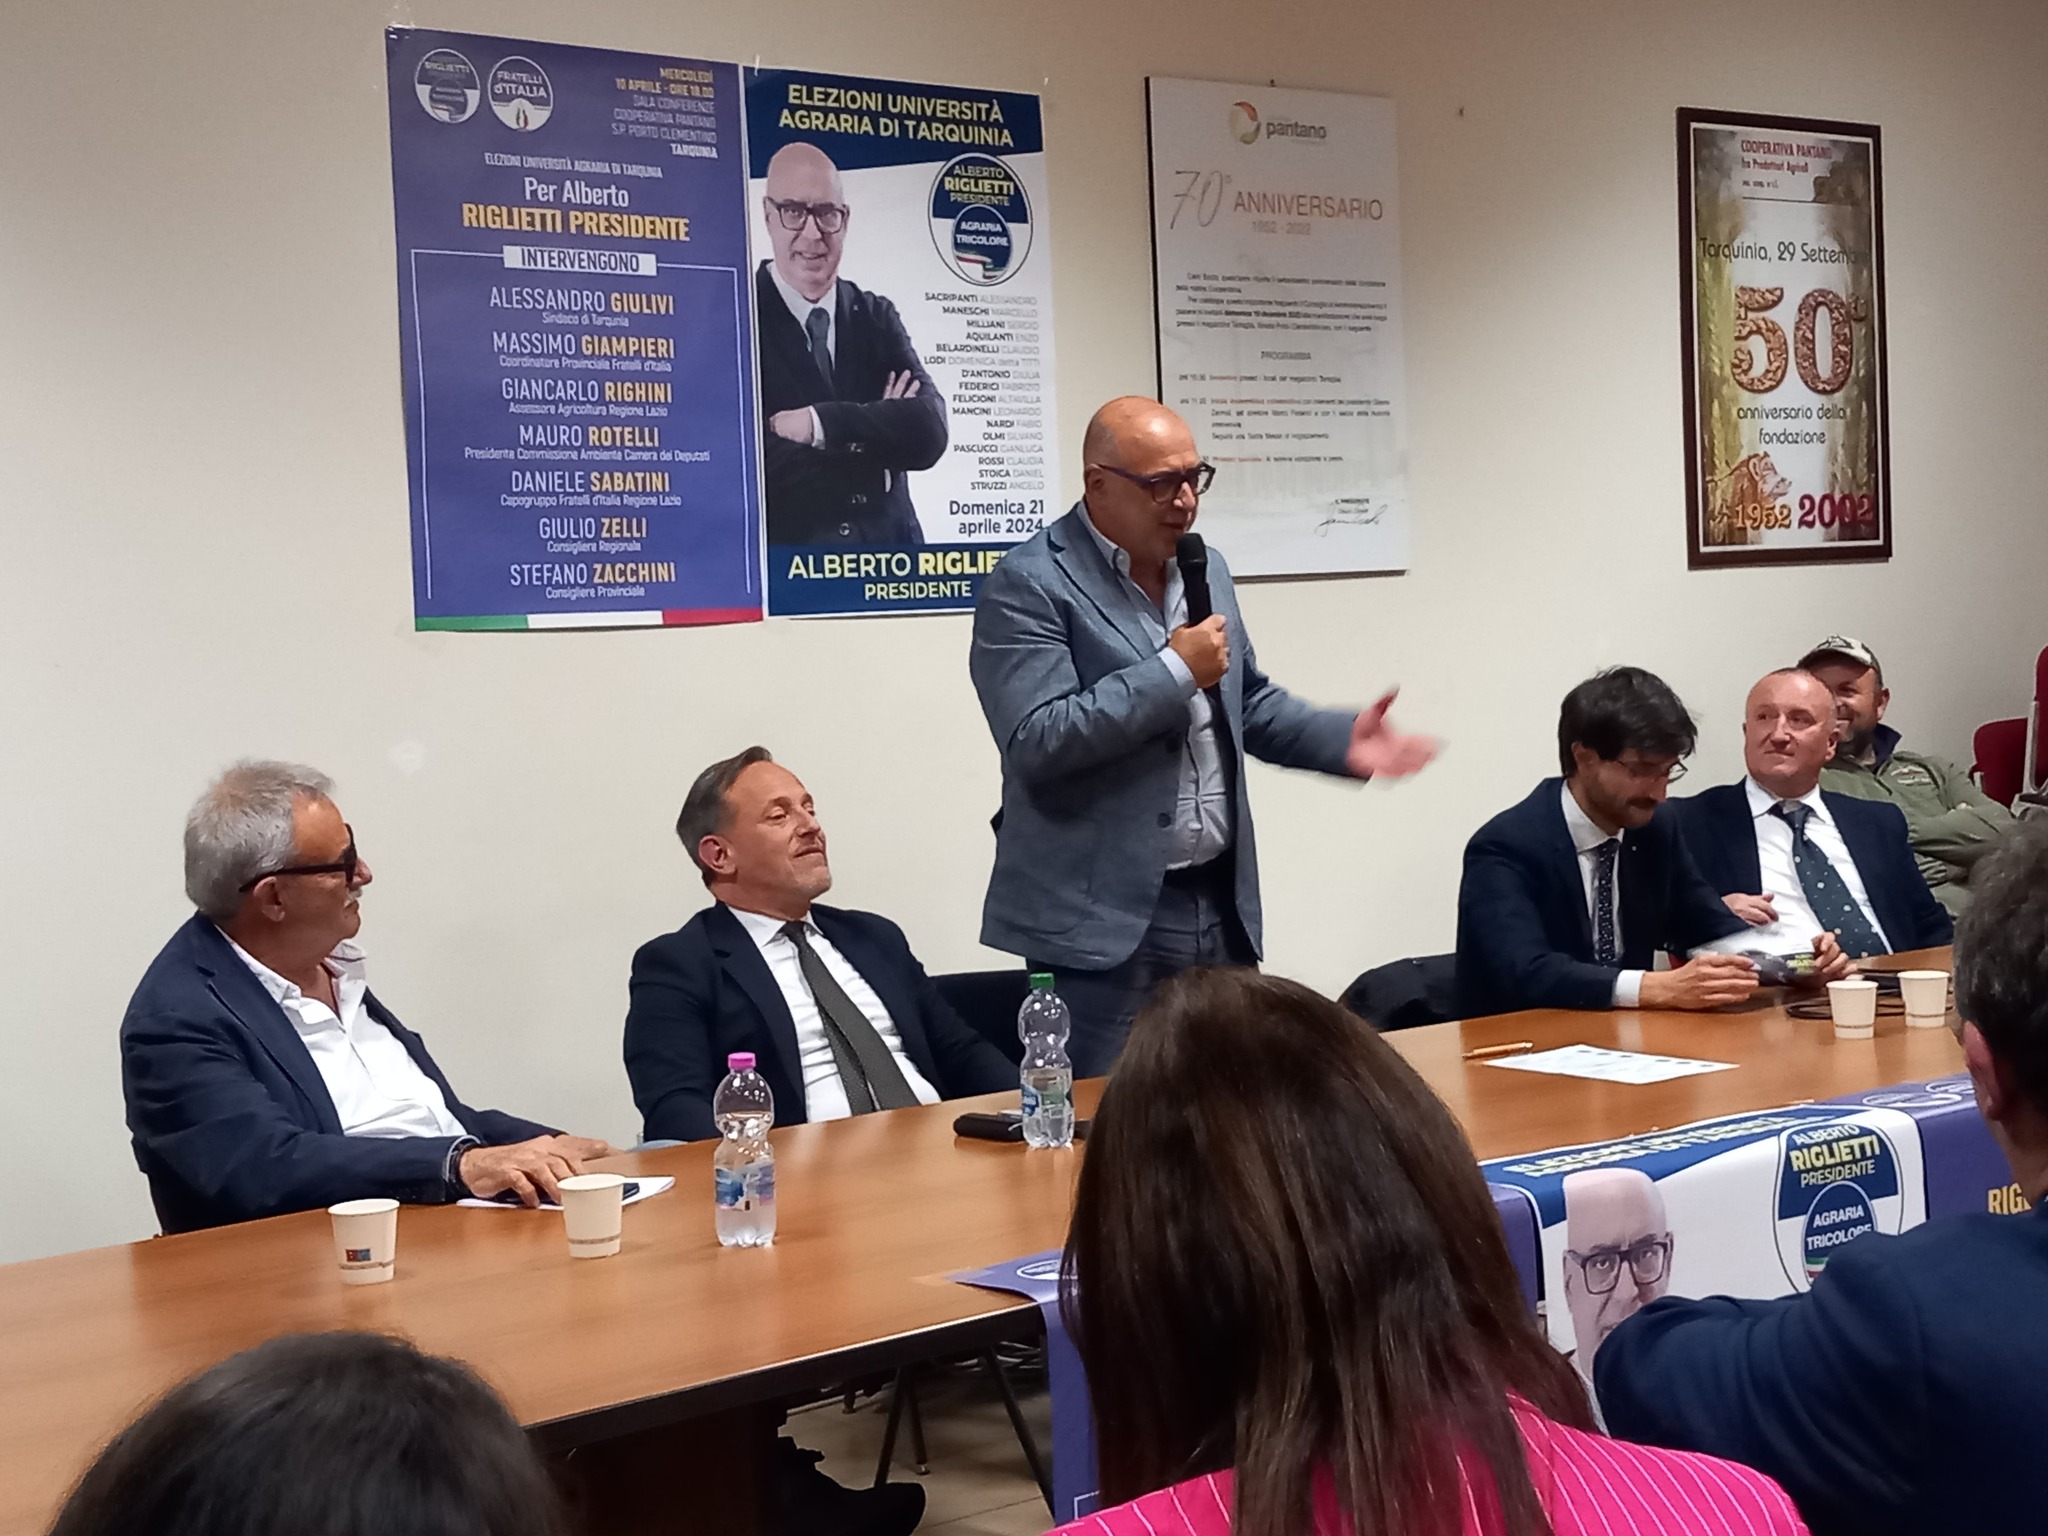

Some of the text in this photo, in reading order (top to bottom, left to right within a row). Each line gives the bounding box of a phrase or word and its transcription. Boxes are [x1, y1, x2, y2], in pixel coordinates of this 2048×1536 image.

[497, 71, 542, 84] FRATELLI
[628, 79, 662, 93] APRILE
[669, 83, 689, 96] ORE
[633, 94, 714, 113] SALA CONFERENZE
[788, 84, 1004, 123] ELEZIONI UNIVERSITÀ
[614, 108, 716, 128] COOPERATIVA PANTANO
[628, 125, 659, 138] PORTO
[660, 127, 717, 143] CLEMENTINO
[779, 109, 1014, 148] AGRARIA DI TARQUINIA
[1266, 121, 1327, 140] pantano
[670, 143, 718, 158] TARQUINIA
[1741, 140, 1794, 156] COOPERATIVA
[484, 152, 662, 178] ELEZIONI UNIVERSITÀ AGRARIA DI TARQUINIA
[954, 165, 1004, 179] ALBERTO
[524, 177, 629, 207] Per Alberto
[944, 177, 1014, 195] RIGLIETTI
[950, 192, 1010, 206] PRESIDENTE
[1234, 190, 1383, 221] ANNIVERSARIO
[462, 203, 690, 241] RIGLIETTI PRESIDENTE
[961, 221, 1002, 232] AGRARIA
[1252, 221, 1277, 234] 1952
[956, 234, 1009, 246] TRICOLORE
[1700, 237, 1772, 263] Tarquinia,
[1777, 241, 1796, 262] 29
[521, 248, 640, 273] INTERVENGONO
[490, 286, 674, 315] ALESSANDRO GIULIVI
[925, 292, 978, 303] SACRIPANTI
[542, 312, 579, 325] Sindaco
[581, 313, 589, 325] di
[942, 306, 989, 316] MANESCHI
[493, 331, 675, 359] MASSIMO GIAMPIERI
[966, 332, 1013, 342] AQUILANTI
[936, 343, 999, 353] BELARDINELLI
[500, 355, 559, 369] Coordinatore
[561, 357, 610, 370] Provinciale
[612, 358, 641, 371] Fratelli
[924, 356, 946, 365] LODI
[502, 378, 672, 403] GIANCARLO RIGHINI
[509, 401, 668, 418] Assessore Agricoltura Regione Lazio
[952, 407, 991, 416] MANCINI
[1737, 403, 1846, 420] anniversario della
[987, 420, 1014, 428] NARDI
[519, 424, 660, 447] MAURO ROTELLI
[982, 432, 1005, 441] OLMI
[1759, 427, 1826, 444] fondazione
[465, 447, 710, 463] Presidente Commissione Ambiente Camera dei Deputati
[978, 457, 1004, 465] ROSSI
[512, 471, 670, 493] DANIELE SABATINI
[978, 469, 1011, 478] STOICA
[971, 481, 1007, 490] STRUZZI
[500, 494, 557, 508] Capogruppo
[559, 495, 590, 506] Fratelli
[623, 495, 658, 508] Regione
[659, 495, 682, 506] Lazio
[949, 499, 1044, 515] Domenica 21
[1735, 493, 1873, 530] 1952 2002
[539, 517, 647, 539] GIULIO ZELLI
[958, 518, 1044, 538] aprile 2024
[547, 540, 641, 555] Consigliere Regionale
[510, 562, 676, 586] STEFANO ZACCHINI
[788, 552, 911, 580] ALBERTO
[546, 585, 645, 600] Consigliere Provinciale
[864, 580, 972, 601] PRESIDENTE
[1792, 1124, 1860, 1146] ALBERTO
[1789, 1135, 1880, 1172] RIGLIETTI
[1800, 1159, 1875, 1188] PRESIDENTE
[1813, 1205, 1864, 1228] AGRARIA
